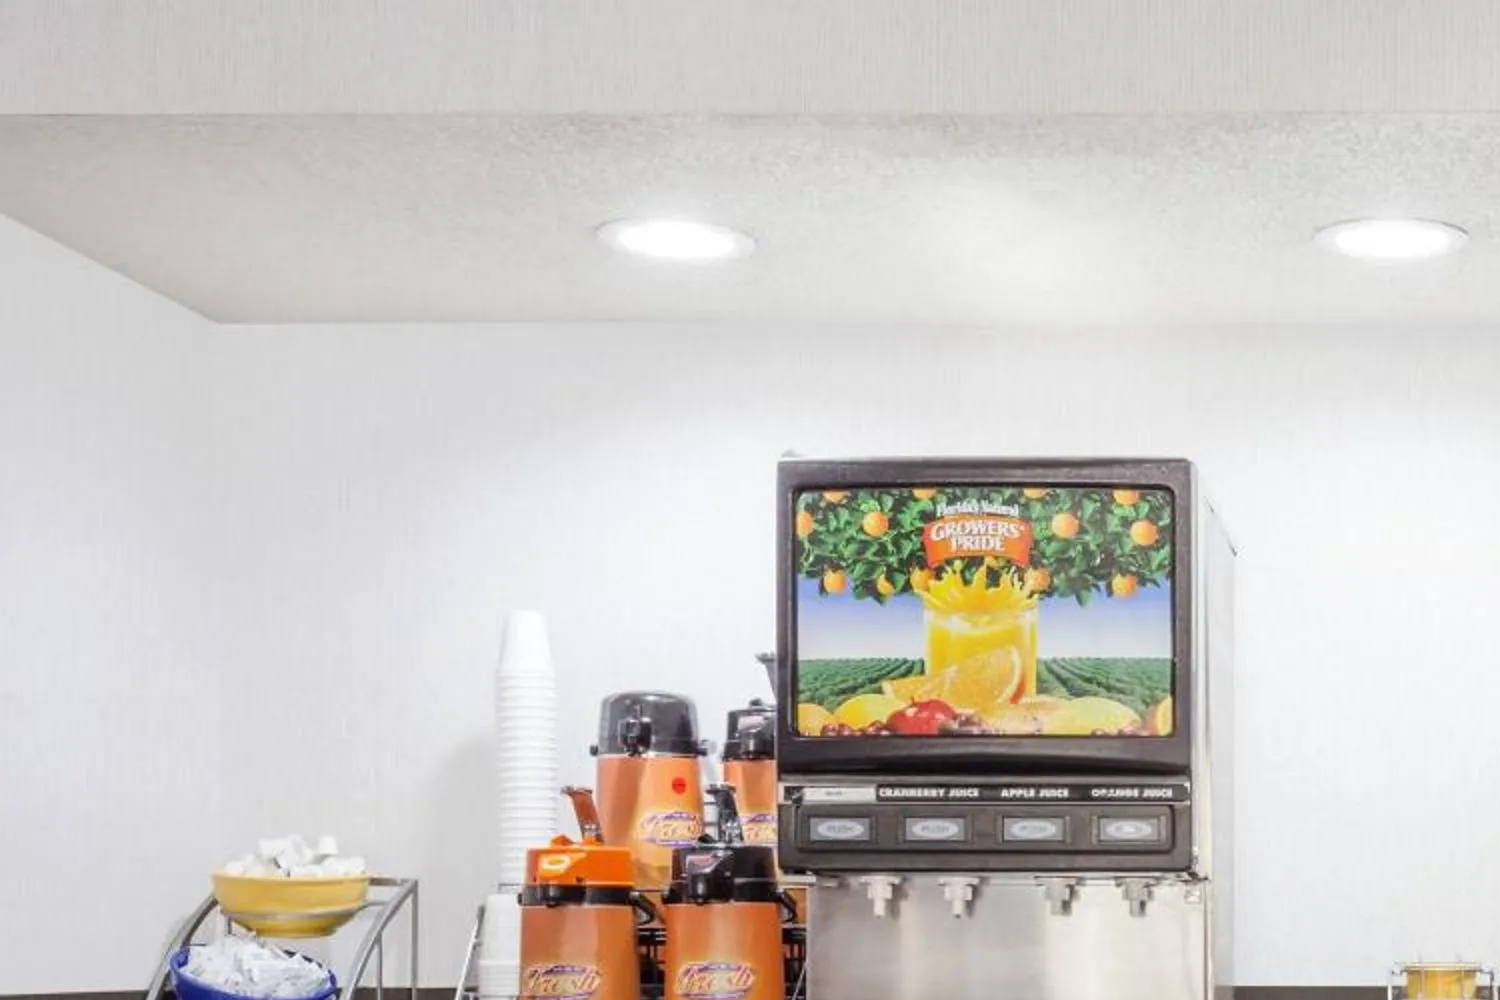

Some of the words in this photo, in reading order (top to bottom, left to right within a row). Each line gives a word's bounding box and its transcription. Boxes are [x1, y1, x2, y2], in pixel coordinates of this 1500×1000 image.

[950, 535, 1005, 552] PRIDE
[879, 787, 945, 798] CRANBERRY
[949, 787, 980, 798] JUICE
[1001, 787, 1035, 798] APPLE
[1039, 787, 1069, 798] JUICE
[1091, 787, 1139, 798] ORANGE
[1143, 787, 1173, 798] JUICE
